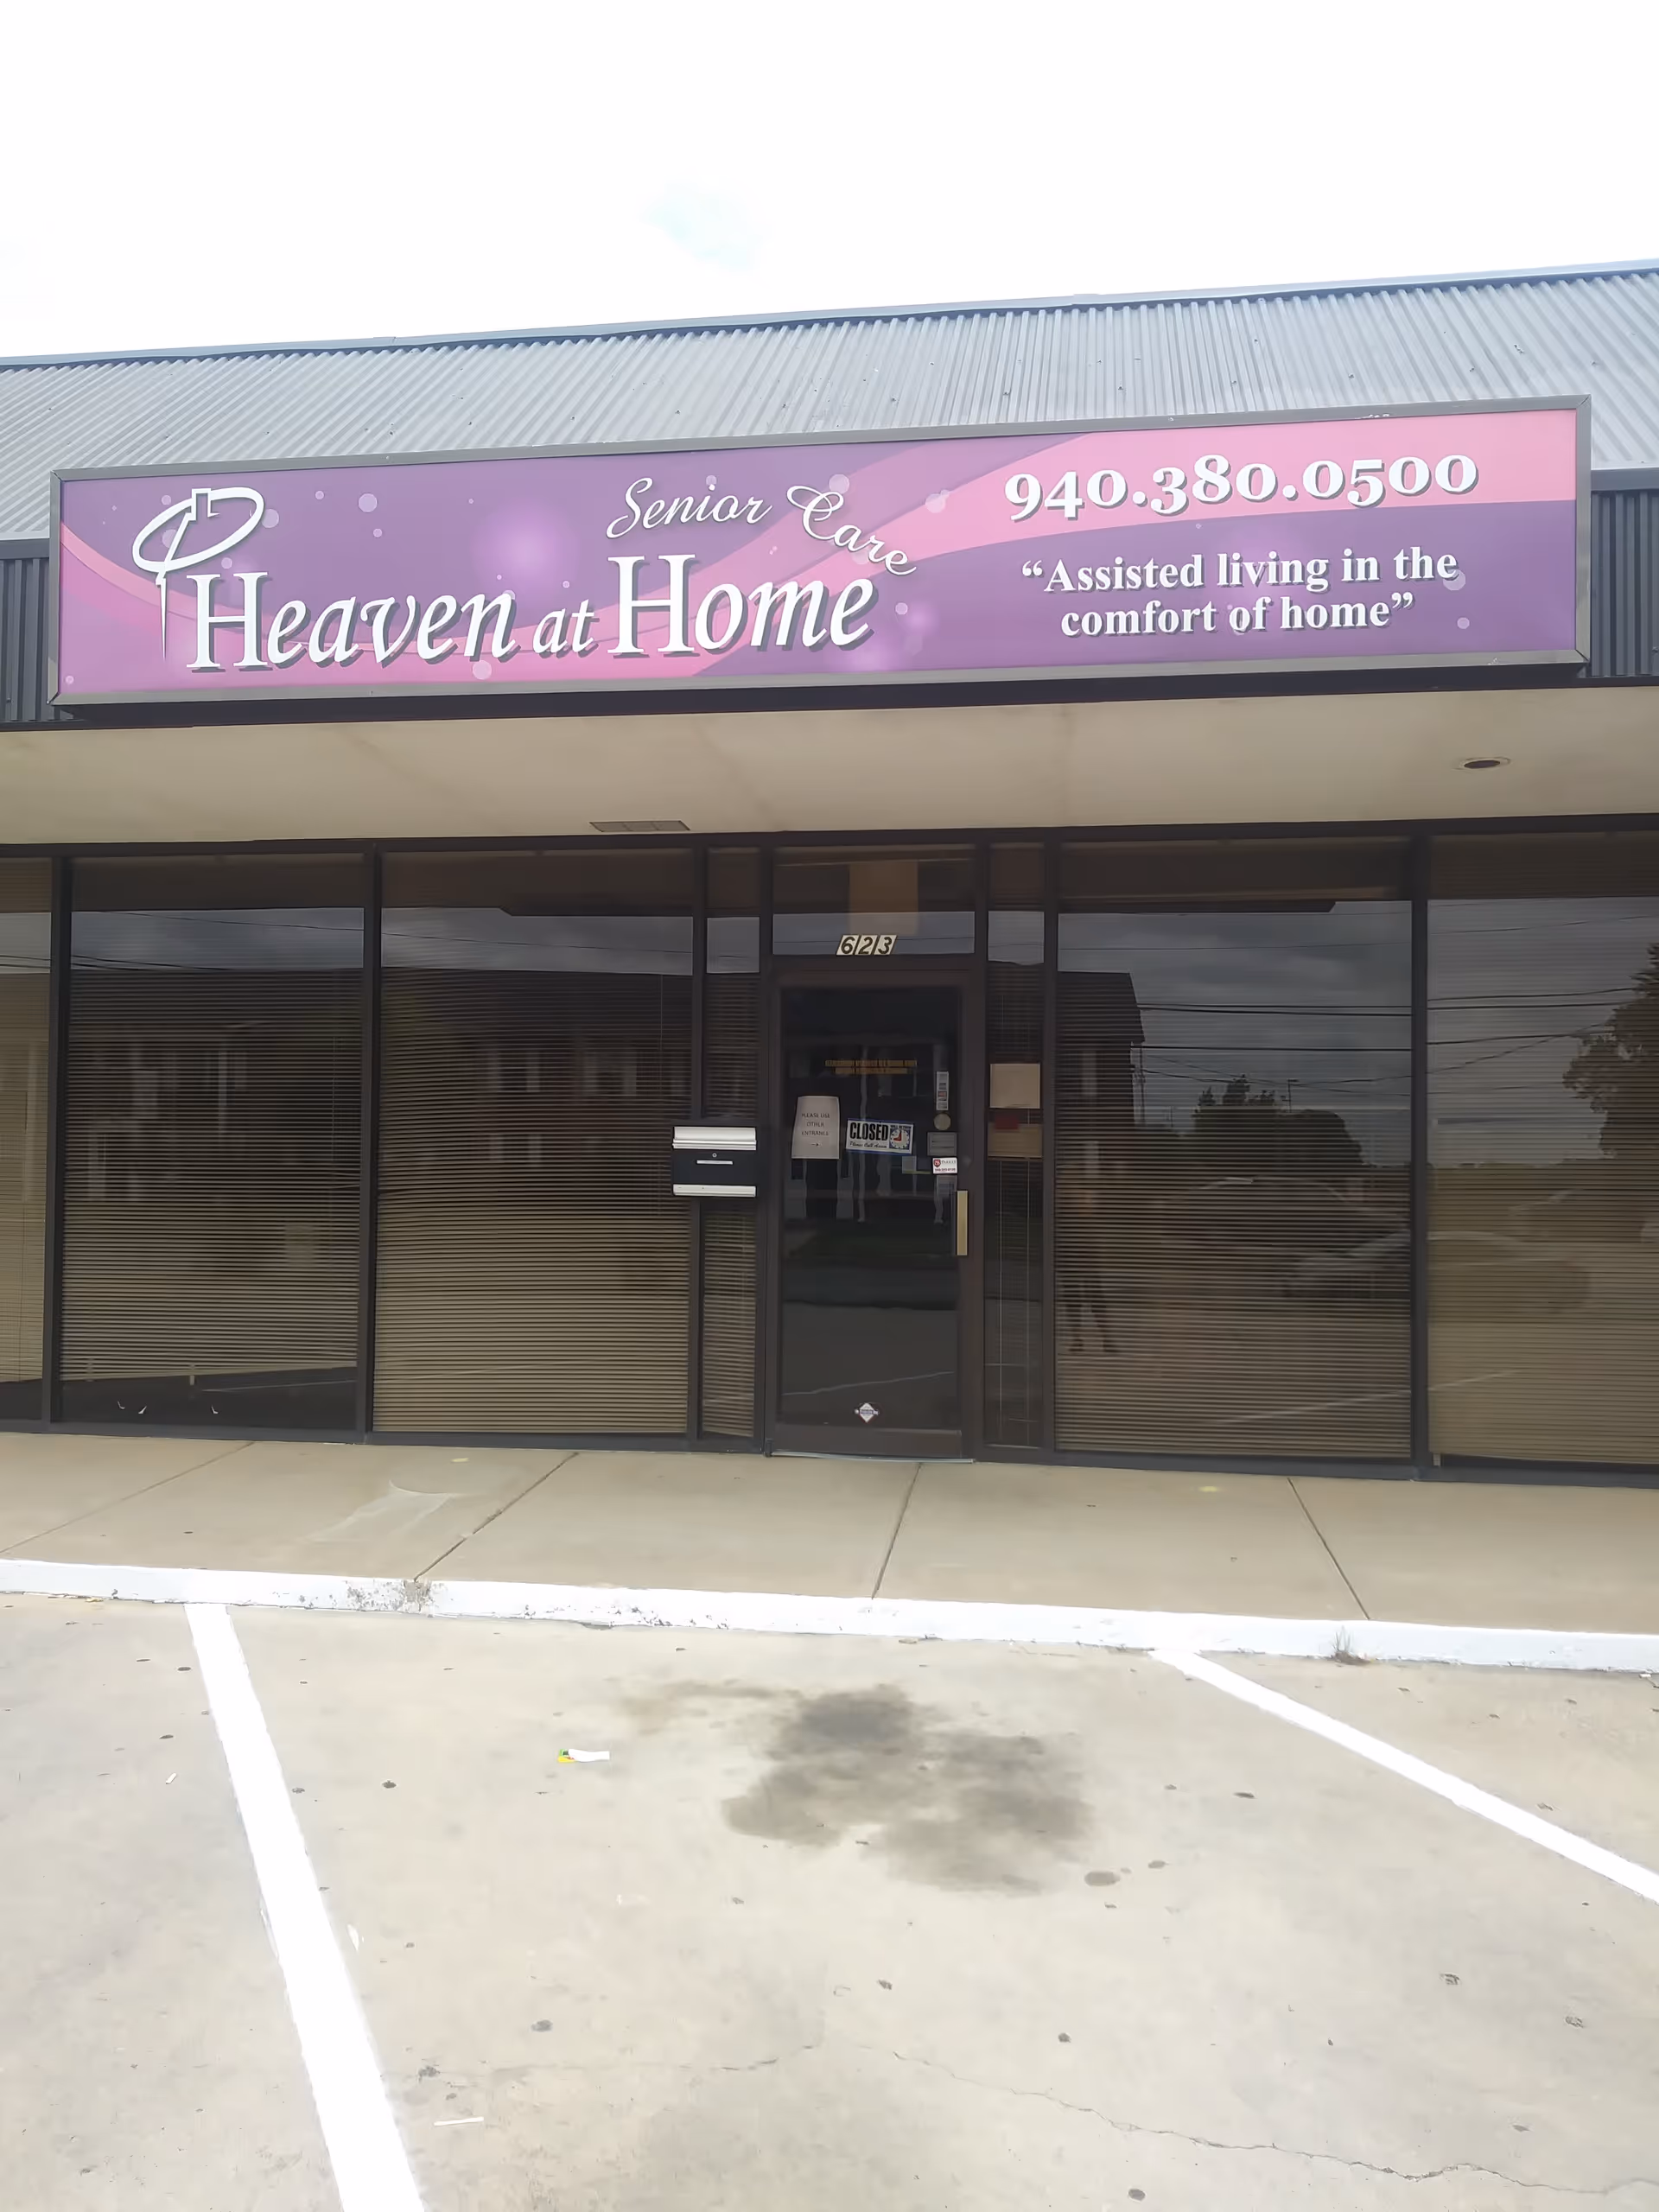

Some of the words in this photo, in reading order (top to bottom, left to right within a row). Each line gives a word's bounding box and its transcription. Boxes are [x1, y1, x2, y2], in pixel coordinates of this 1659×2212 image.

[1004, 454, 1478, 522] 940.380.0500
[606, 477, 773, 540] Senior
[786, 484, 916, 576] Care
[1022, 554, 1205, 592] “Assisted
[1217, 551, 1329, 592] living
[1341, 550, 1380, 582] in
[1394, 547, 1458, 581] the
[187, 571, 517, 671] Heaven
[532, 598, 596, 655] at
[607, 554, 874, 657] Home
[1060, 601, 1217, 638] comfort
[1229, 597, 1271, 633] of
[1280, 593, 1414, 629] home”
[841, 936, 893, 955] 623
[849, 1122, 889, 1141] CLOSED
